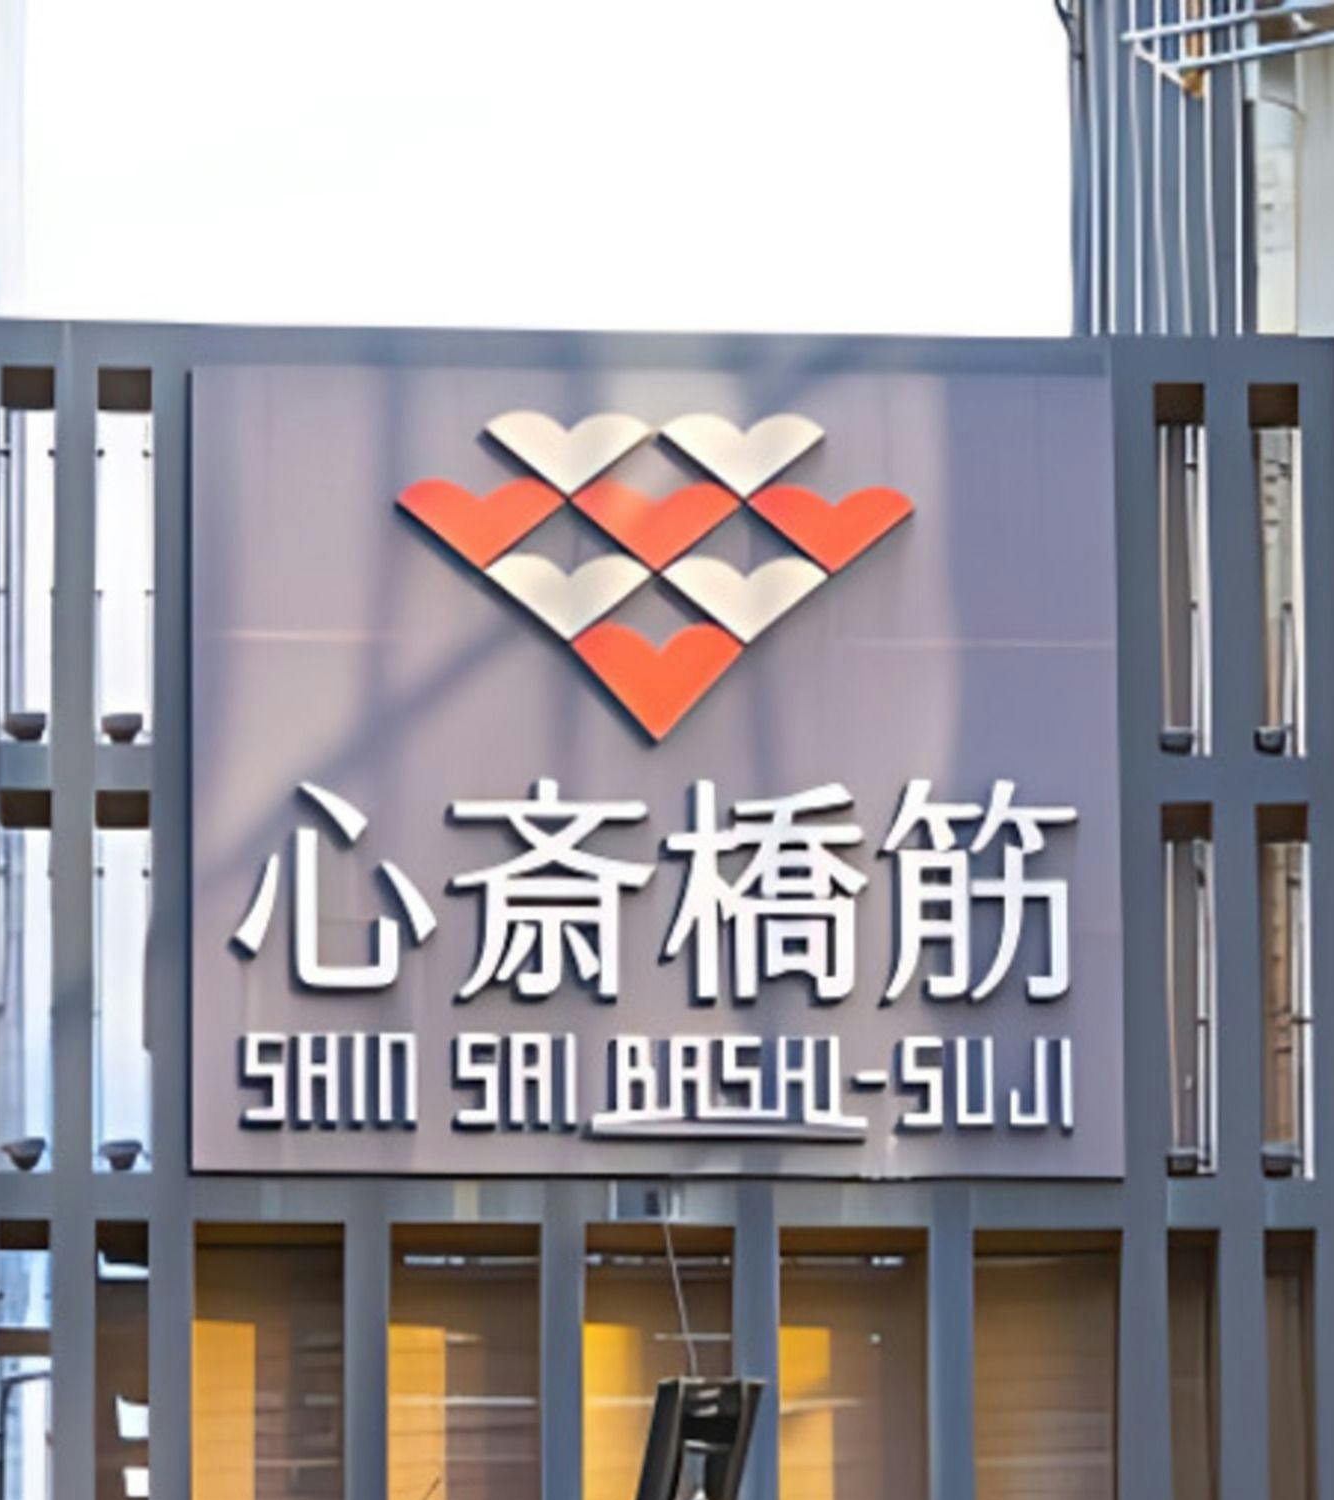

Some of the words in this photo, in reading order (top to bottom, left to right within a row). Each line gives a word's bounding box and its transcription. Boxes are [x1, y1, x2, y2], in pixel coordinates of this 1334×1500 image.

[233, 778, 1079, 1003] 心斎橋筋
[243, 1032, 417, 1122] SHIN
[455, 1032, 577, 1124] SAI
